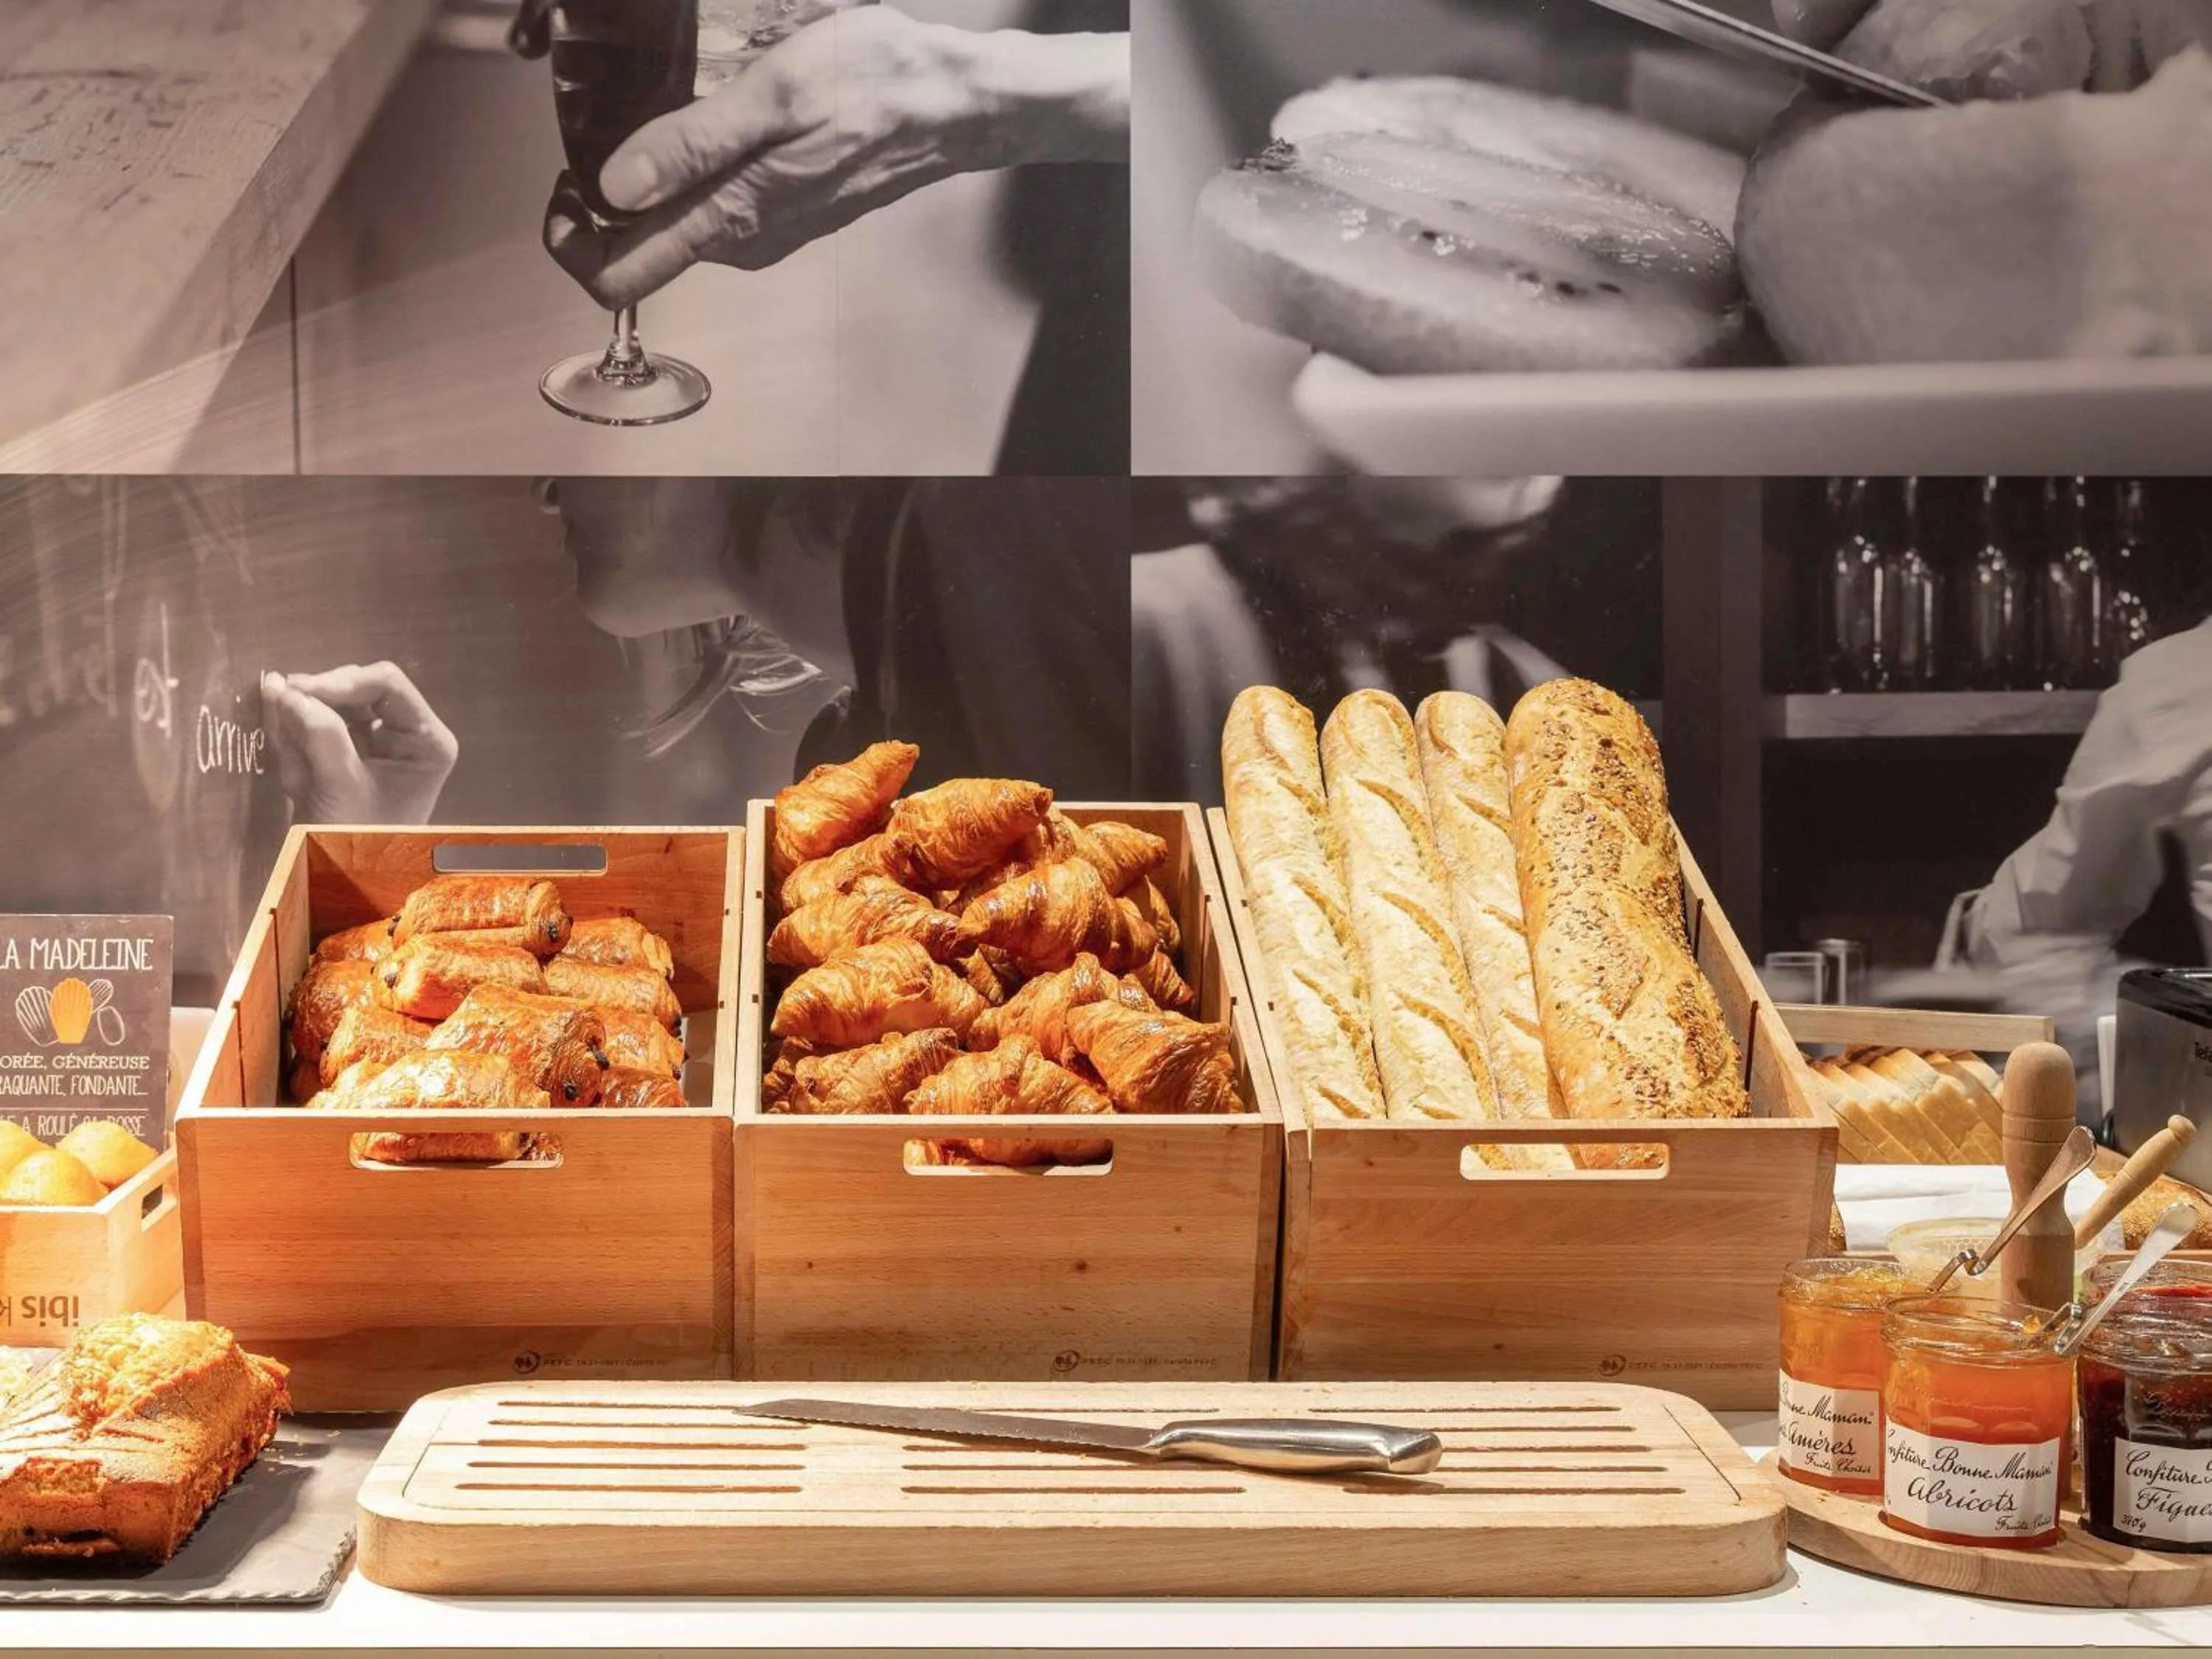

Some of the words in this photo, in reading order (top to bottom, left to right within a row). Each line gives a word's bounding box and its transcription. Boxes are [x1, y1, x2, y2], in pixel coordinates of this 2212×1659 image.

[30, 937, 153, 970] MADELEINE
[52, 1052, 150, 1069] GÉNÉREUSE
[21, 1295, 79, 1327] ibis
[1888, 1428, 1931, 1470] nfiture
[1933, 1446, 1993, 1479] Bonne
[2126, 1450, 2202, 1486] Confiture
[1907, 1477, 2019, 1512] Abricots
